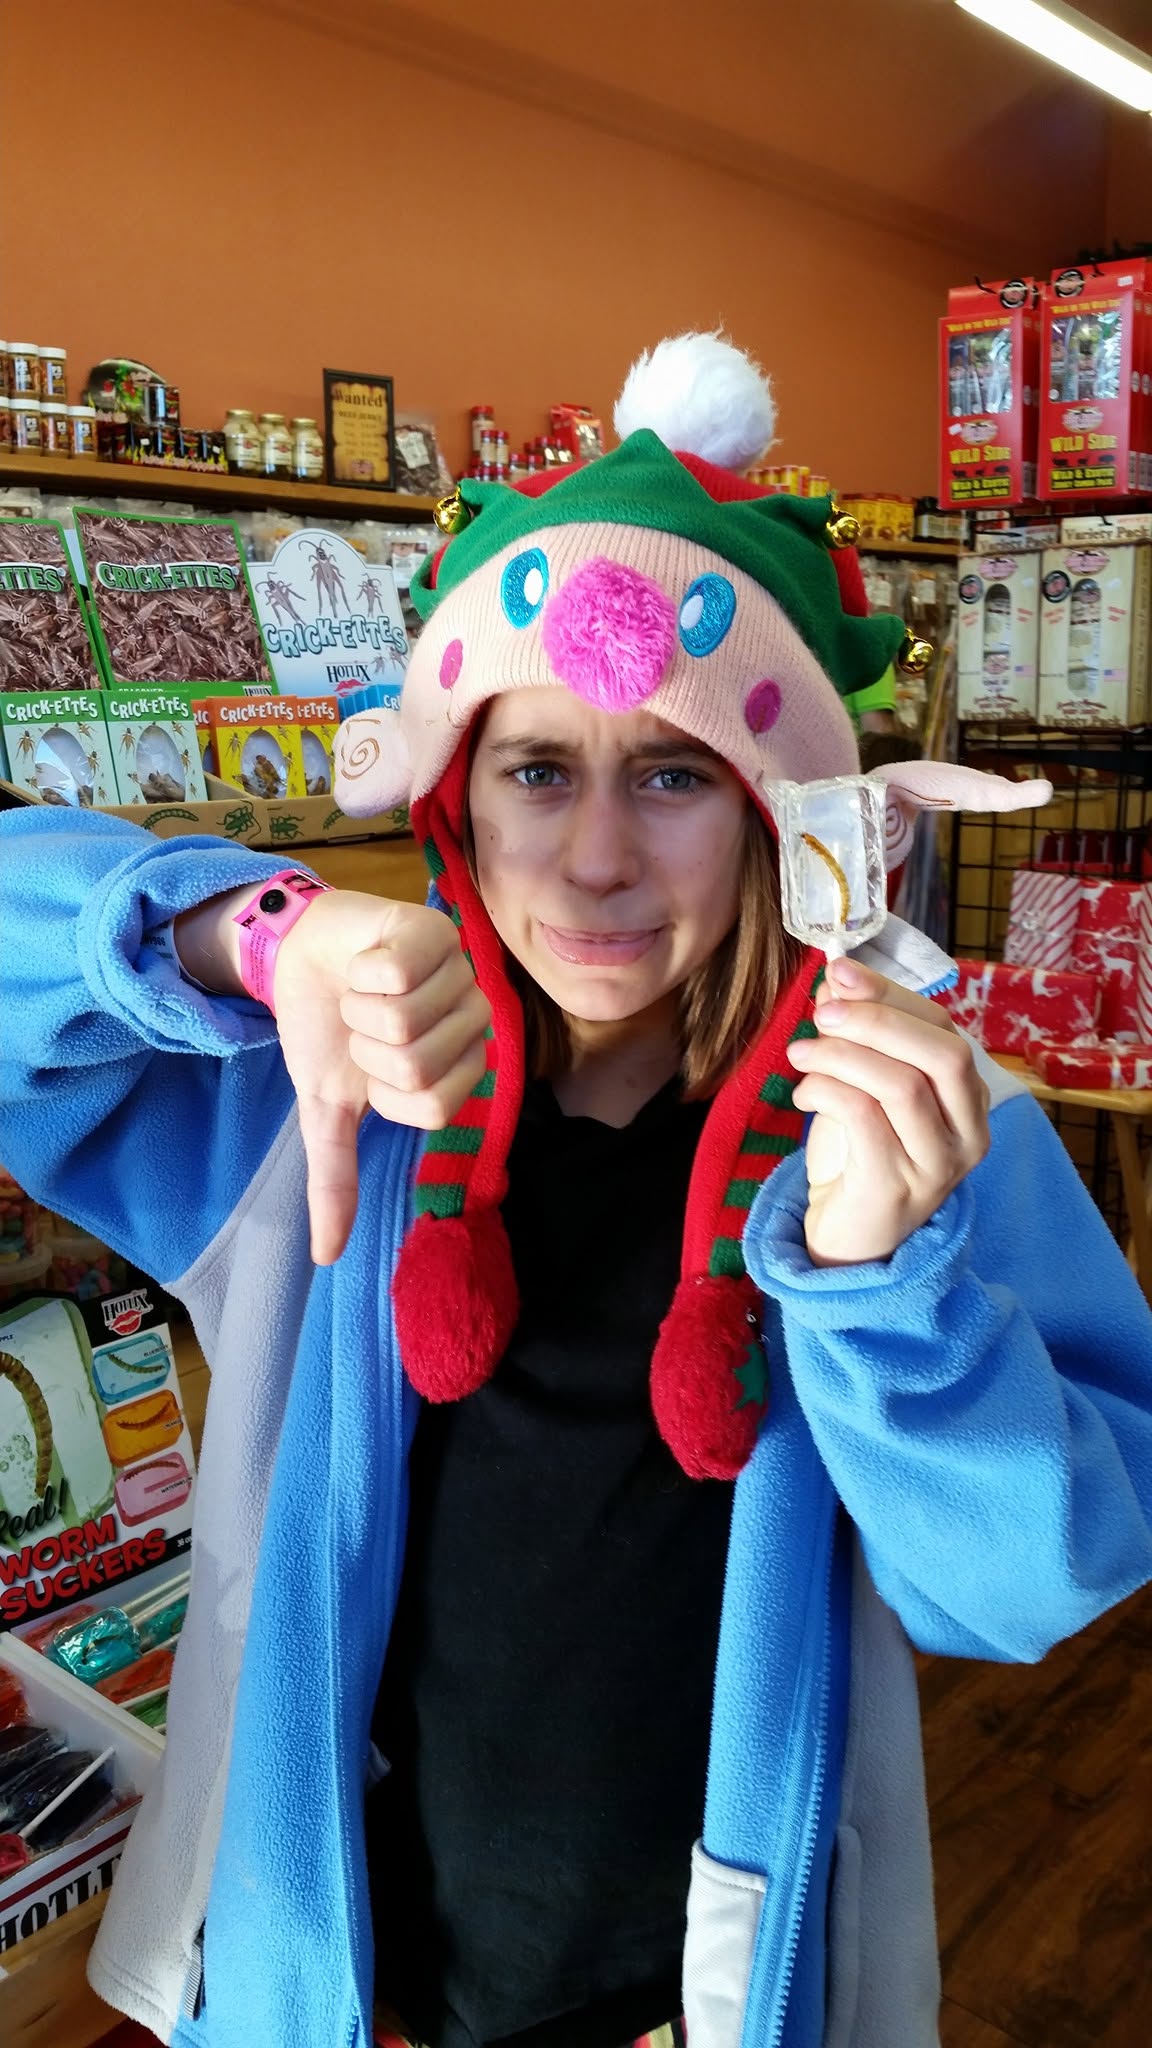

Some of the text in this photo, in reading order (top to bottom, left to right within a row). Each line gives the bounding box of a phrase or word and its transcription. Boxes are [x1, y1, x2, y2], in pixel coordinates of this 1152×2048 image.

[334, 388, 383, 408] Wanted
[949, 444, 1011, 465] WILD SIDE
[1050, 432, 1117, 453] WILD SIDE
[1064, 528, 1113, 541] Variety
[1116, 525, 1150, 538] Pack
[98, 562, 238, 592] CRICK-ETTES
[261, 614, 409, 658] CRICK-ETTES
[326, 664, 373, 683] HOTLIX
[6, 696, 99, 722] CRICK-ETTES
[110, 696, 189, 719] CRICK-ETTES
[220, 701, 295, 724] CRICK-ETTES
[103, 1293, 150, 1321] HOTLIX
[0, 1513, 118, 1586] WORM
[0, 1527, 167, 1621] SUCKERS
[0, 1852, 122, 1954] HOTLI
